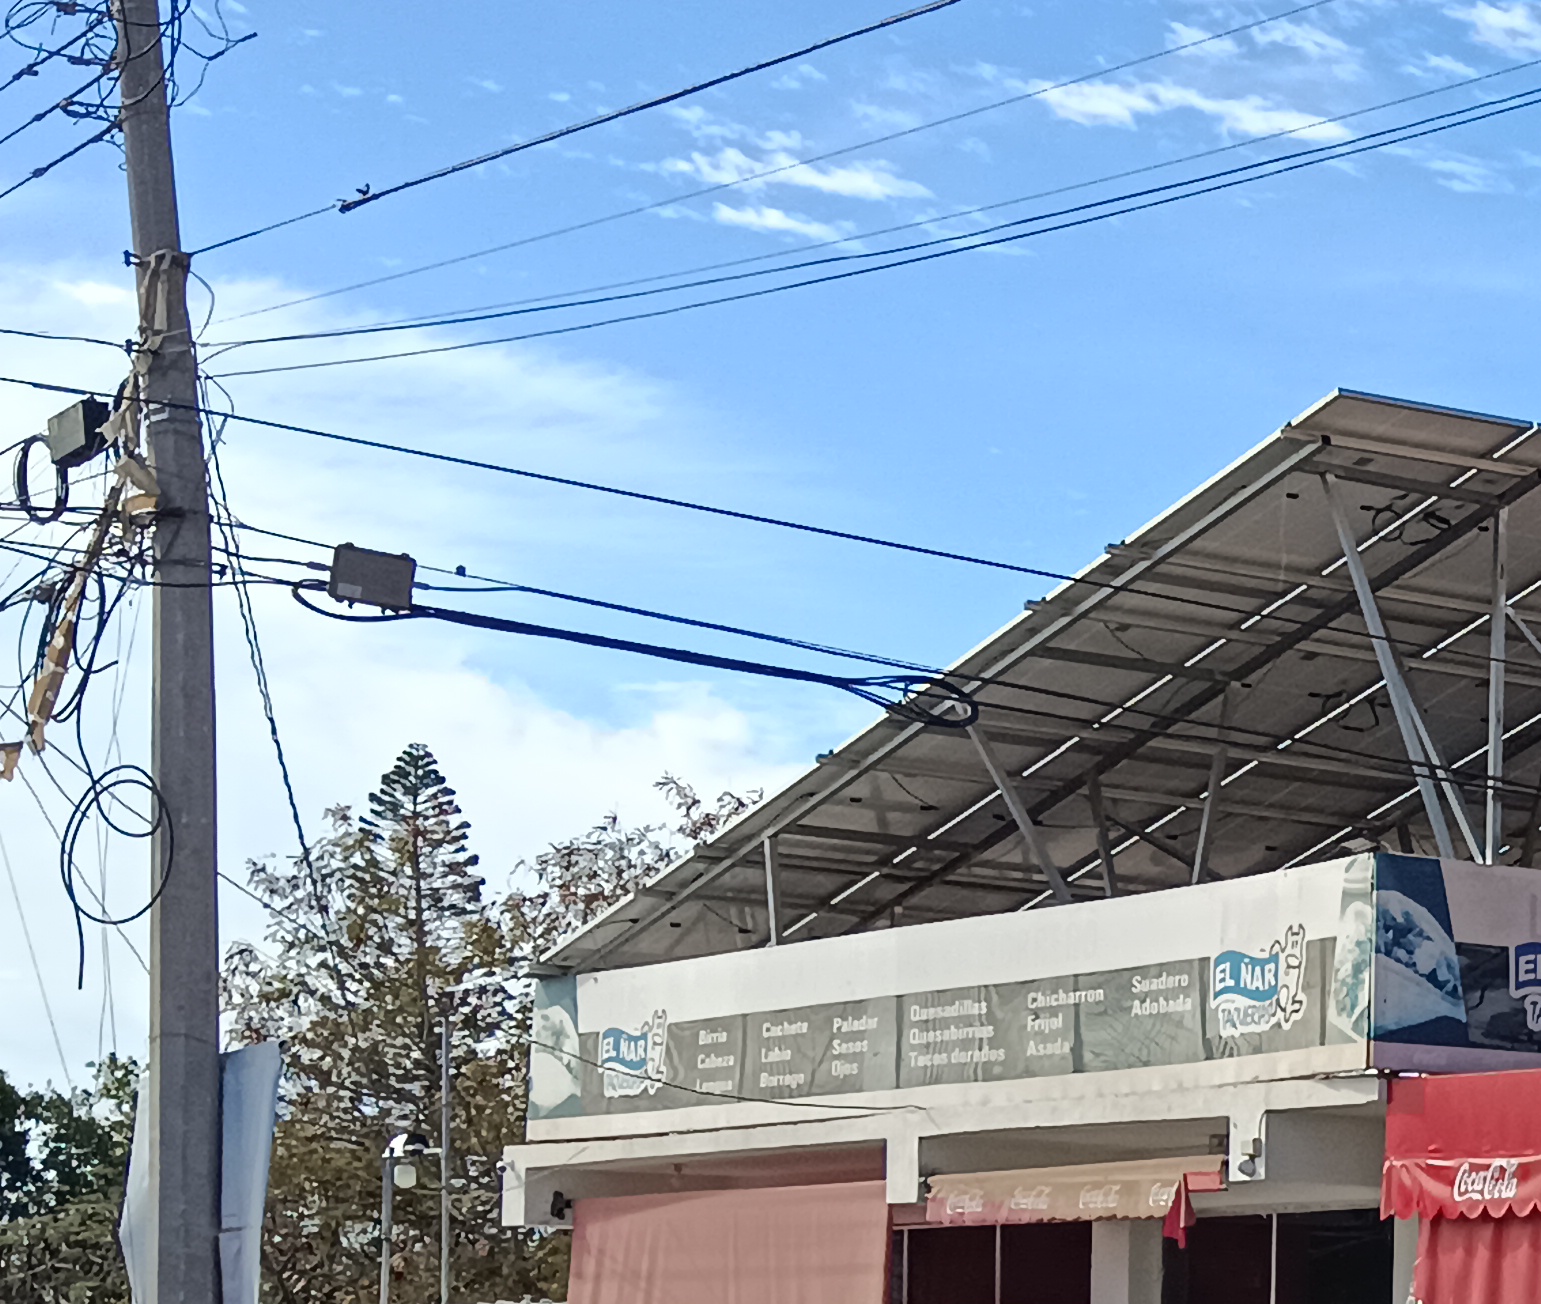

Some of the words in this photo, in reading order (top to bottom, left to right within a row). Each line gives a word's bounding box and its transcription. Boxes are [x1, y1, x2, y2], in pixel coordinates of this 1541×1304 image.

[1131, 972, 1190, 994] Suadero
[1215, 961, 1236, 993] EL
[1240, 957, 1277, 991] ÑAR
[1026, 1012, 1063, 1034] Frijol
[1131, 995, 1193, 1018] Adobada
